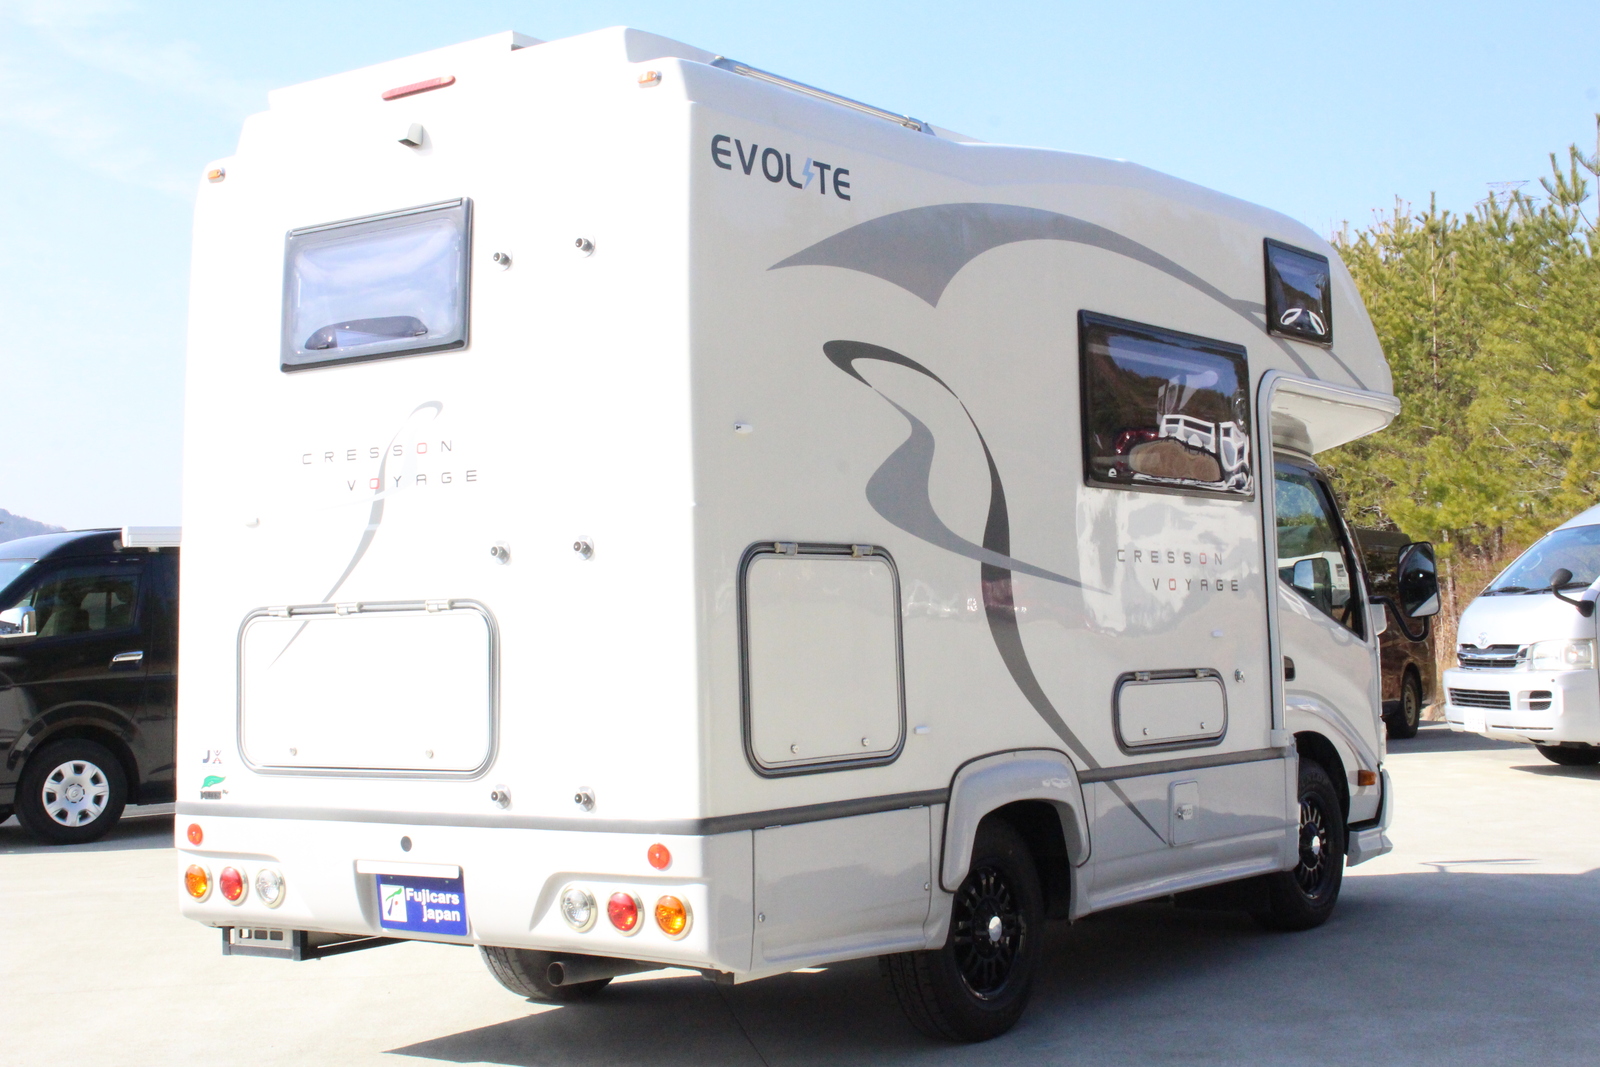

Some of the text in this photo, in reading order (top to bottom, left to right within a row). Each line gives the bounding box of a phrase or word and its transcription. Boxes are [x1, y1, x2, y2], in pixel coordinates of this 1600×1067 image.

[302, 439, 452, 465] CRESSON
[346, 469, 477, 491] VOYAGE
[1116, 549, 1222, 565] CRESSON
[1152, 578, 1239, 592] VOYAGE
[405, 887, 460, 906] Fujicars
